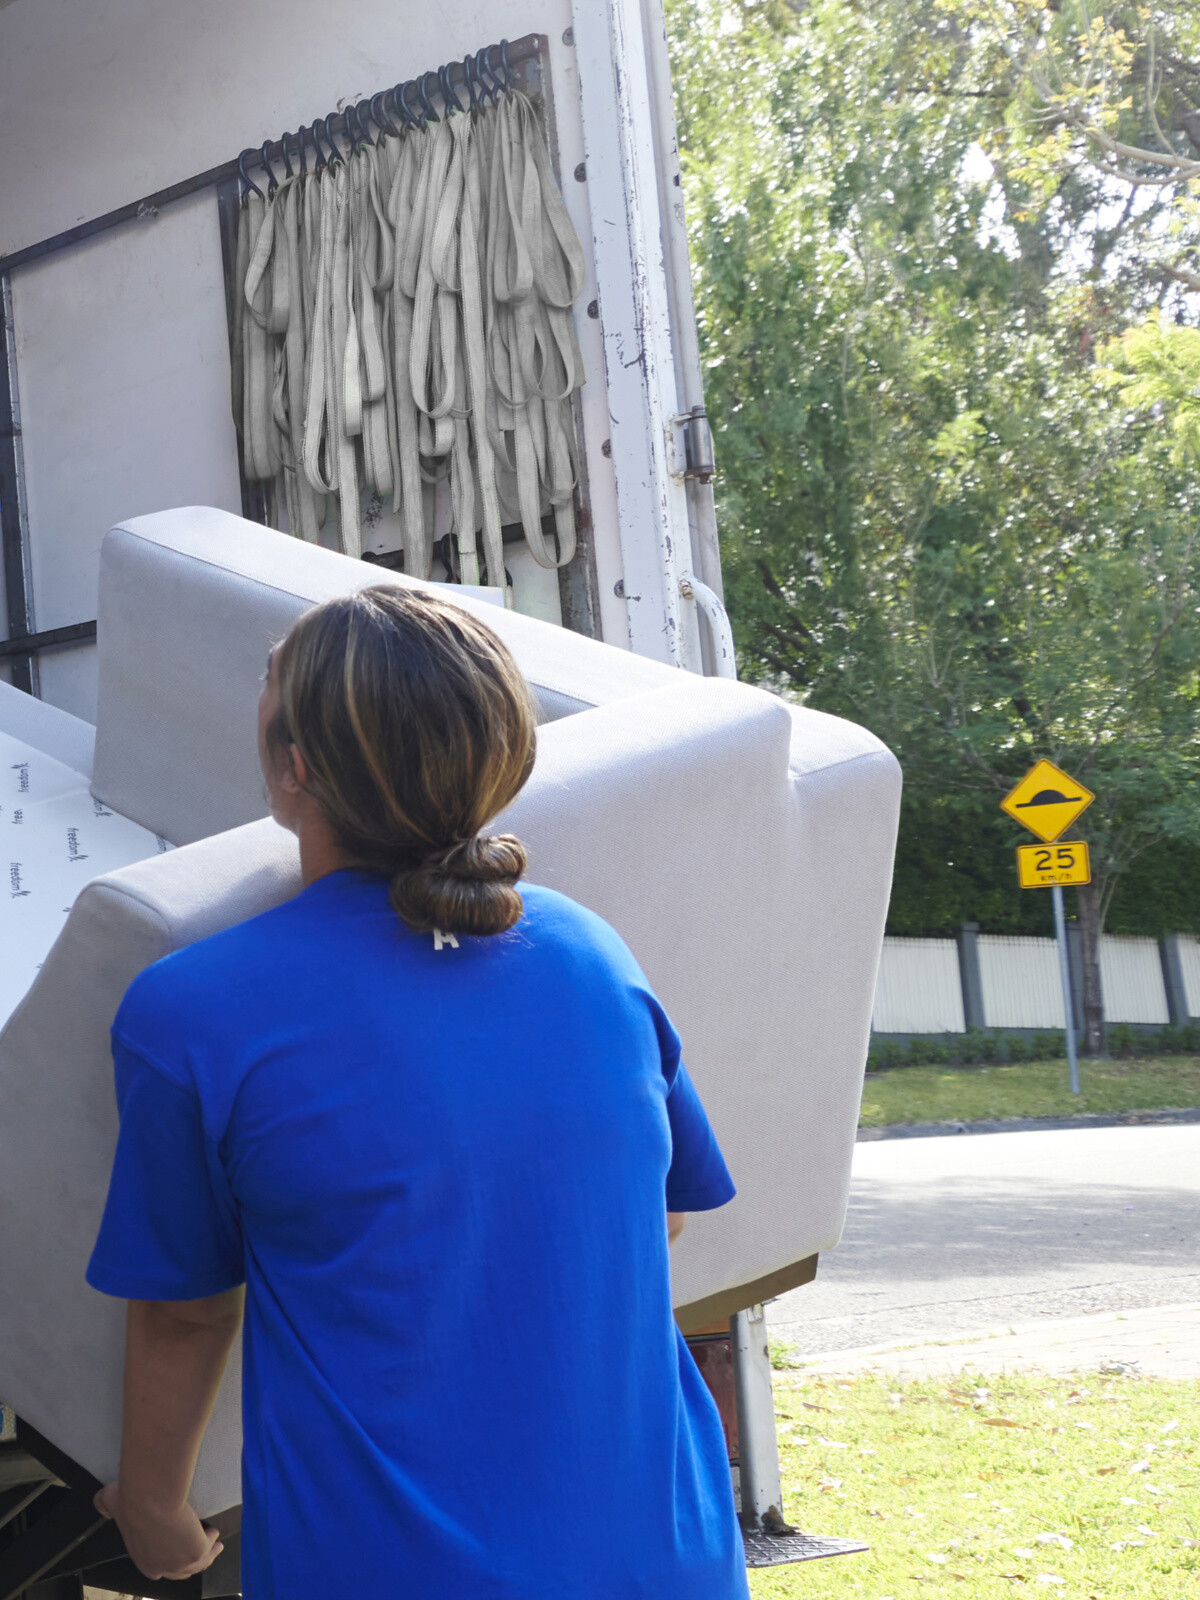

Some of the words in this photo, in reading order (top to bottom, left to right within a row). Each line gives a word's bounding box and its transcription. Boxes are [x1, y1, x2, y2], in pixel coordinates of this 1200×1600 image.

[18, 768, 30, 793] freedom
[68, 828, 79, 856] freedom
[1035, 848, 1075, 871] 25
[10, 862, 22, 891] freedom
